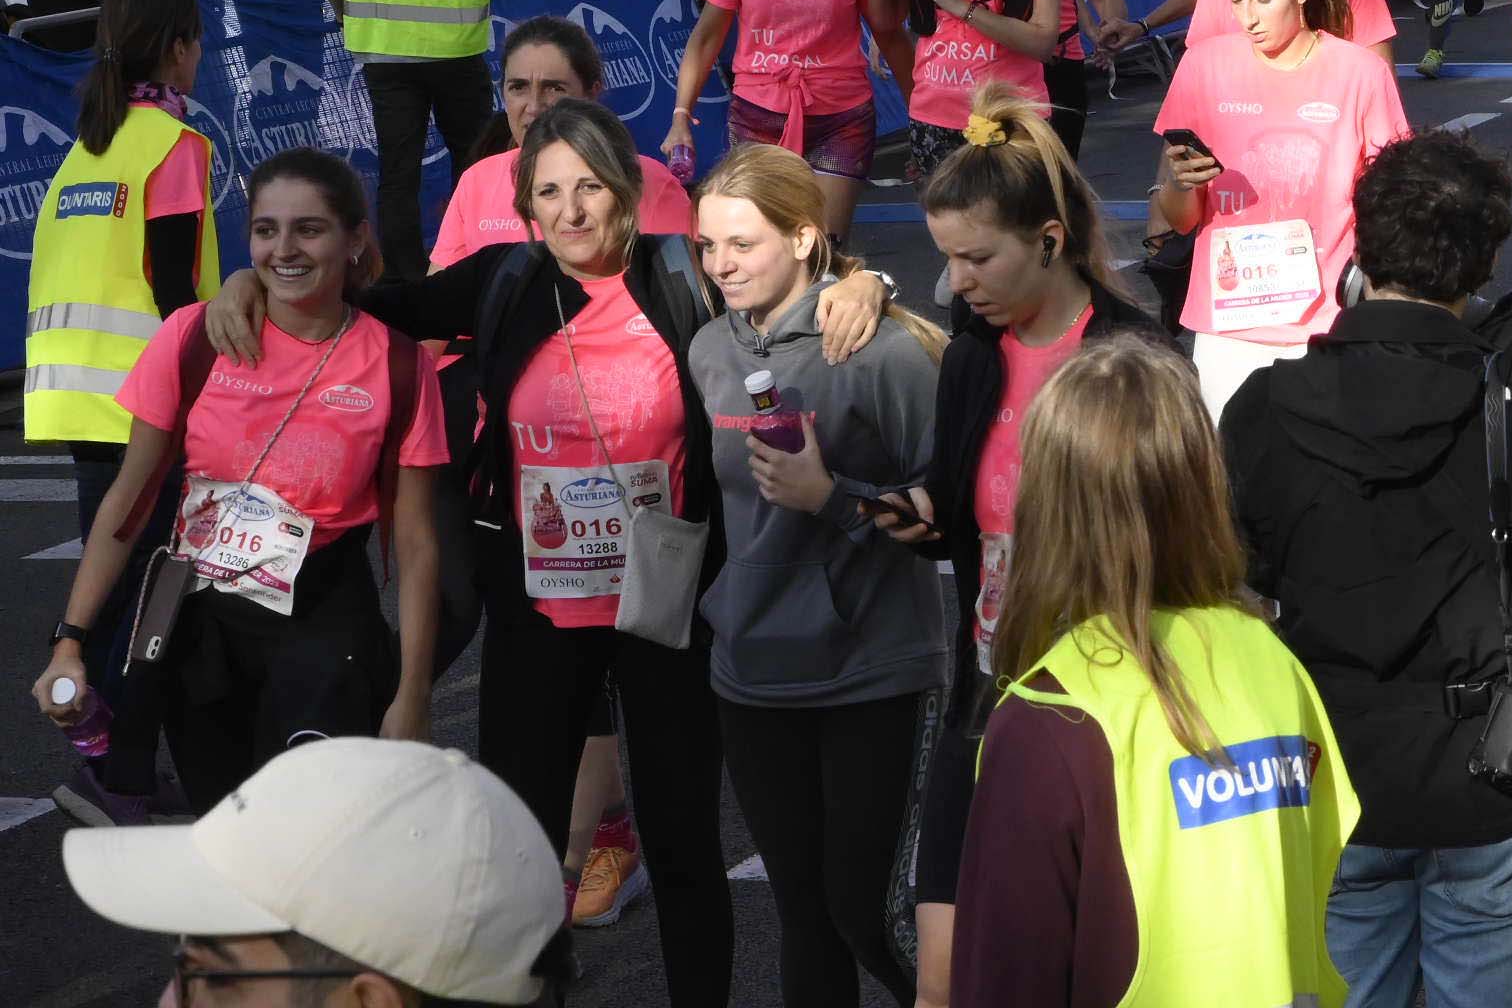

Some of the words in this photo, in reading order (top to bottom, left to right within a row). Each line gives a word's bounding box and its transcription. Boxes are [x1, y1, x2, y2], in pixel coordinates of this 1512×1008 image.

[923, 61, 976, 85] SUMA
[1218, 102, 1263, 115] OYSHO
[478, 218, 521, 232] OYSHO
[211, 371, 273, 395] OYSHO
[512, 421, 554, 454] TU
[570, 517, 622, 538] 016
[220, 526, 263, 553] 016
[578, 542, 618, 555] 13288
[218, 552, 250, 569] 13286
[543, 560, 582, 569] CARRERA
[583, 560, 596, 569] DE
[597, 559, 609, 567] LA
[540, 577, 585, 589] OYSHO
